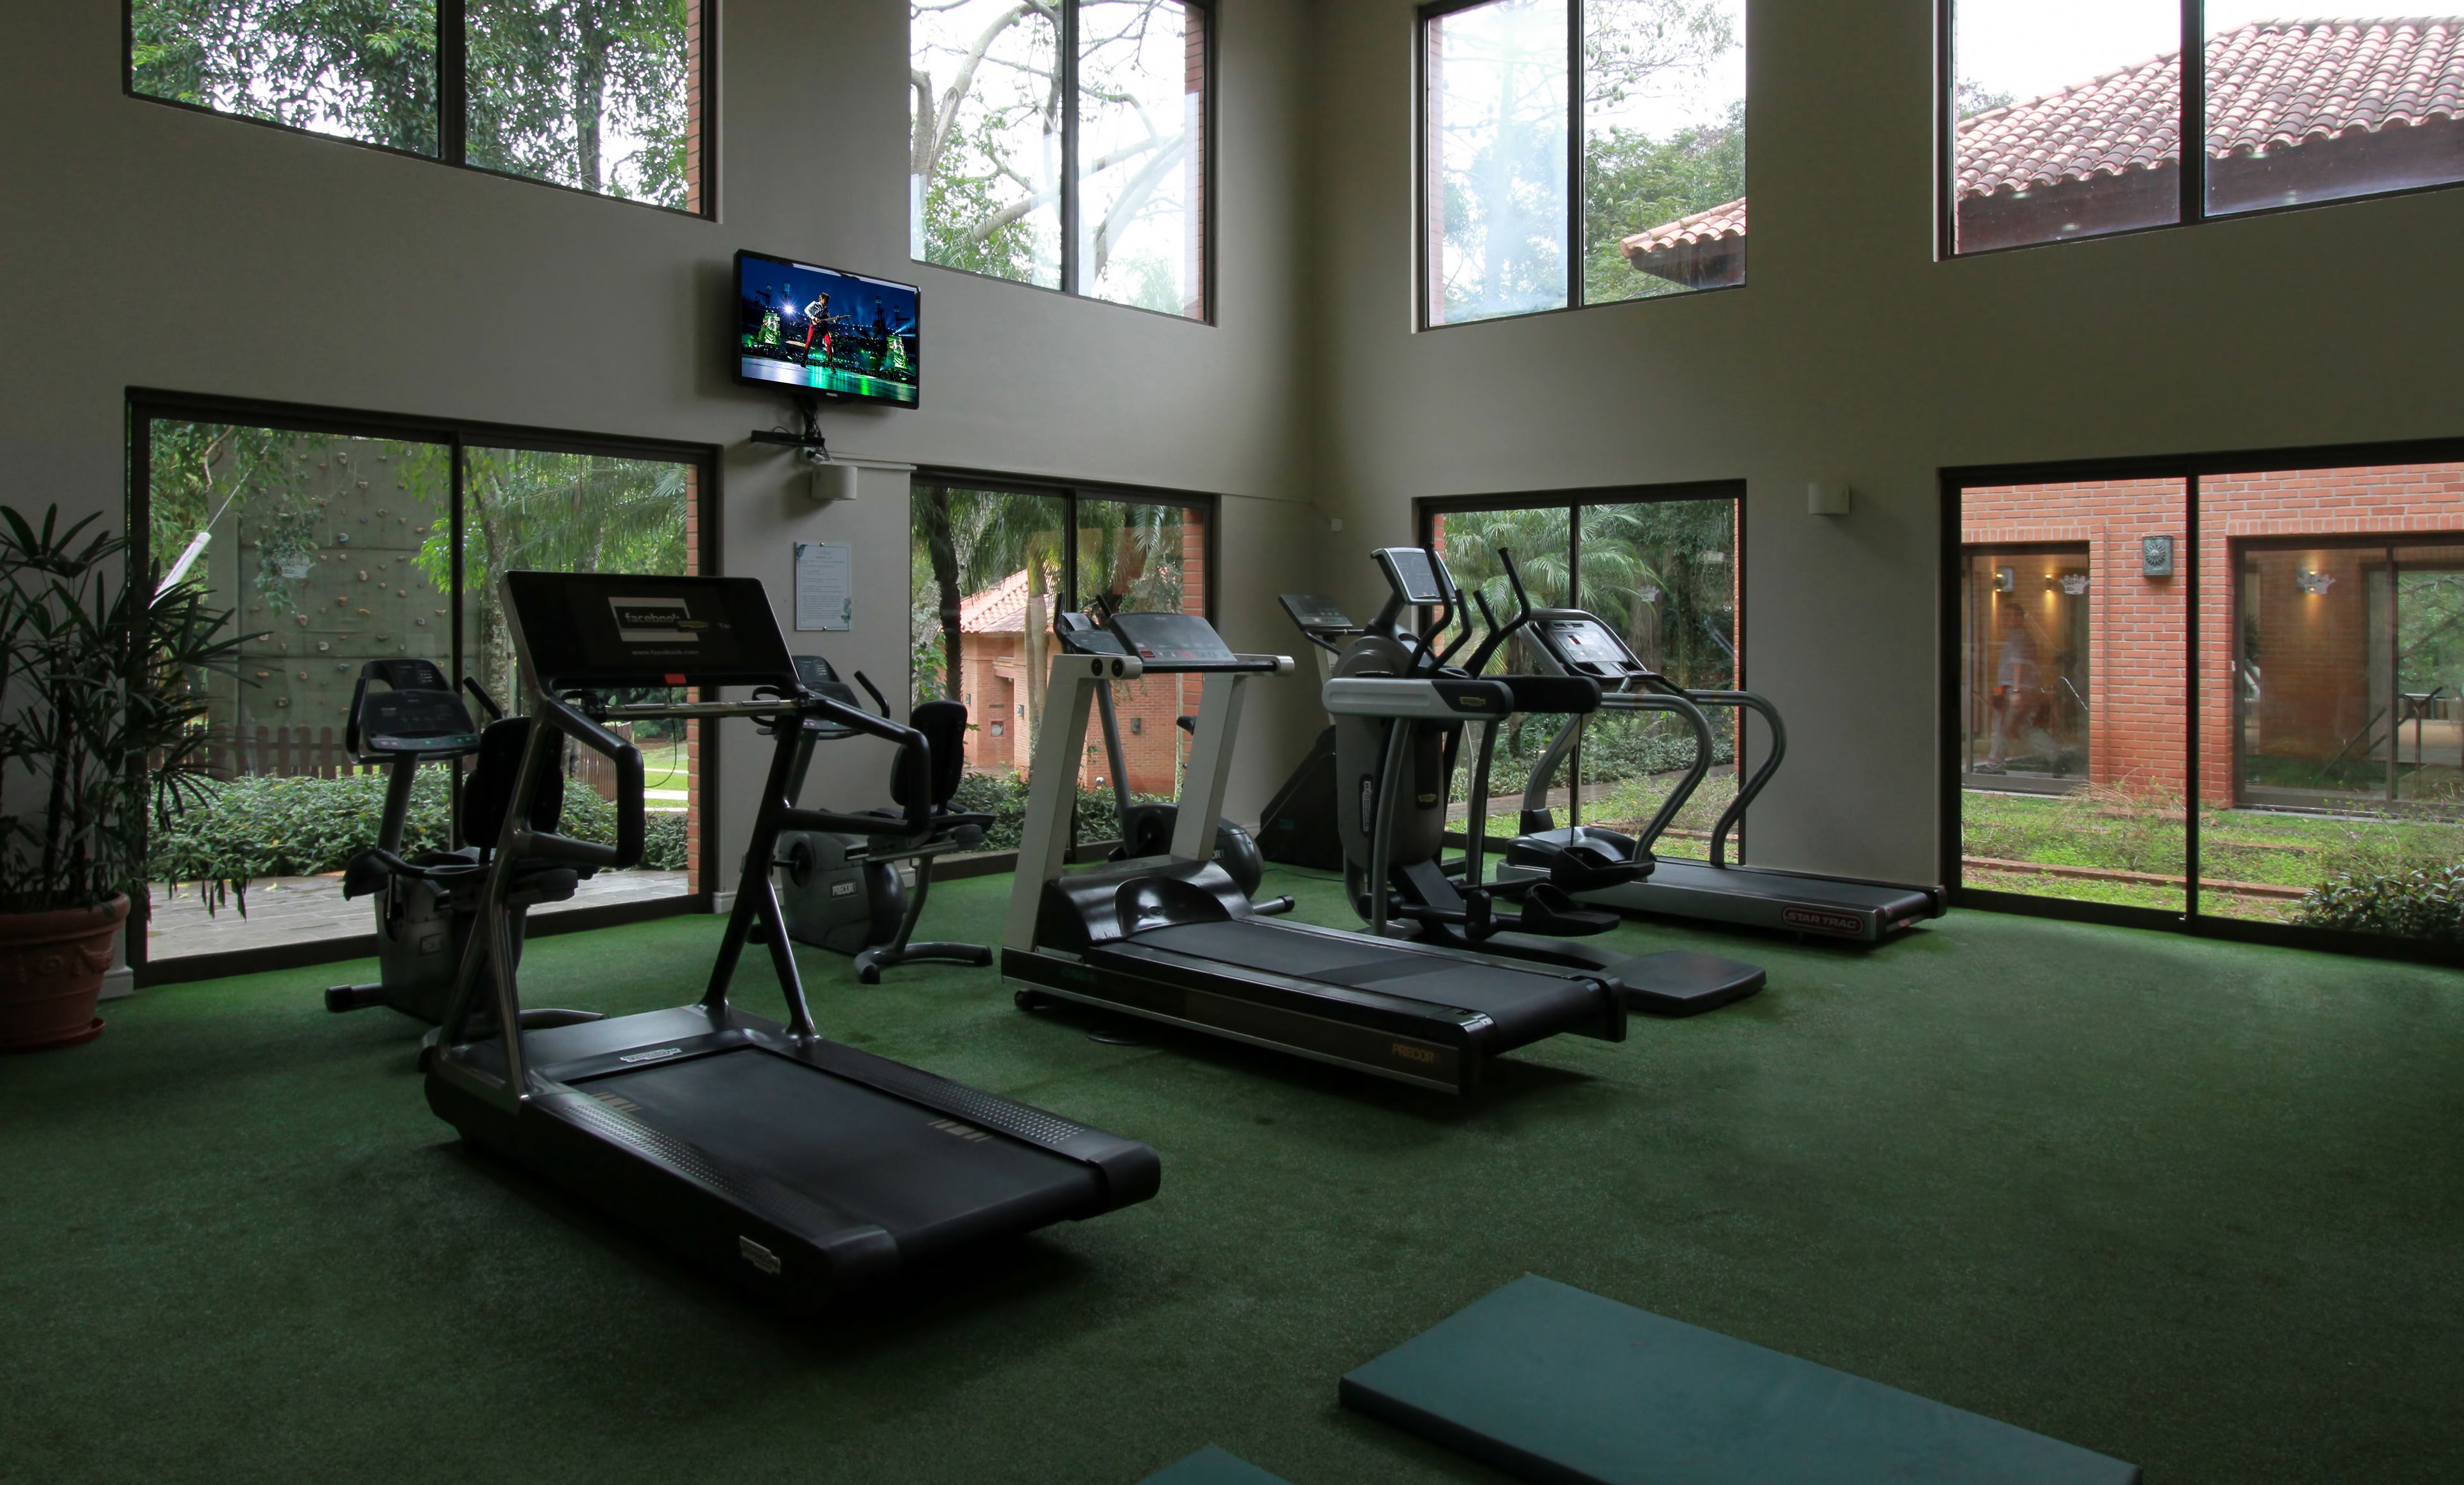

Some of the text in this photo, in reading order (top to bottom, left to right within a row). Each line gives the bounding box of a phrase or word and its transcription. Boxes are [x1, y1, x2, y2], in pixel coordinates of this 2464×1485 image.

[832, 883, 853, 896] PRECOR
[1786, 912, 1857, 929] STAR TRAC
[1392, 1043, 1434, 1063] PRECOR
